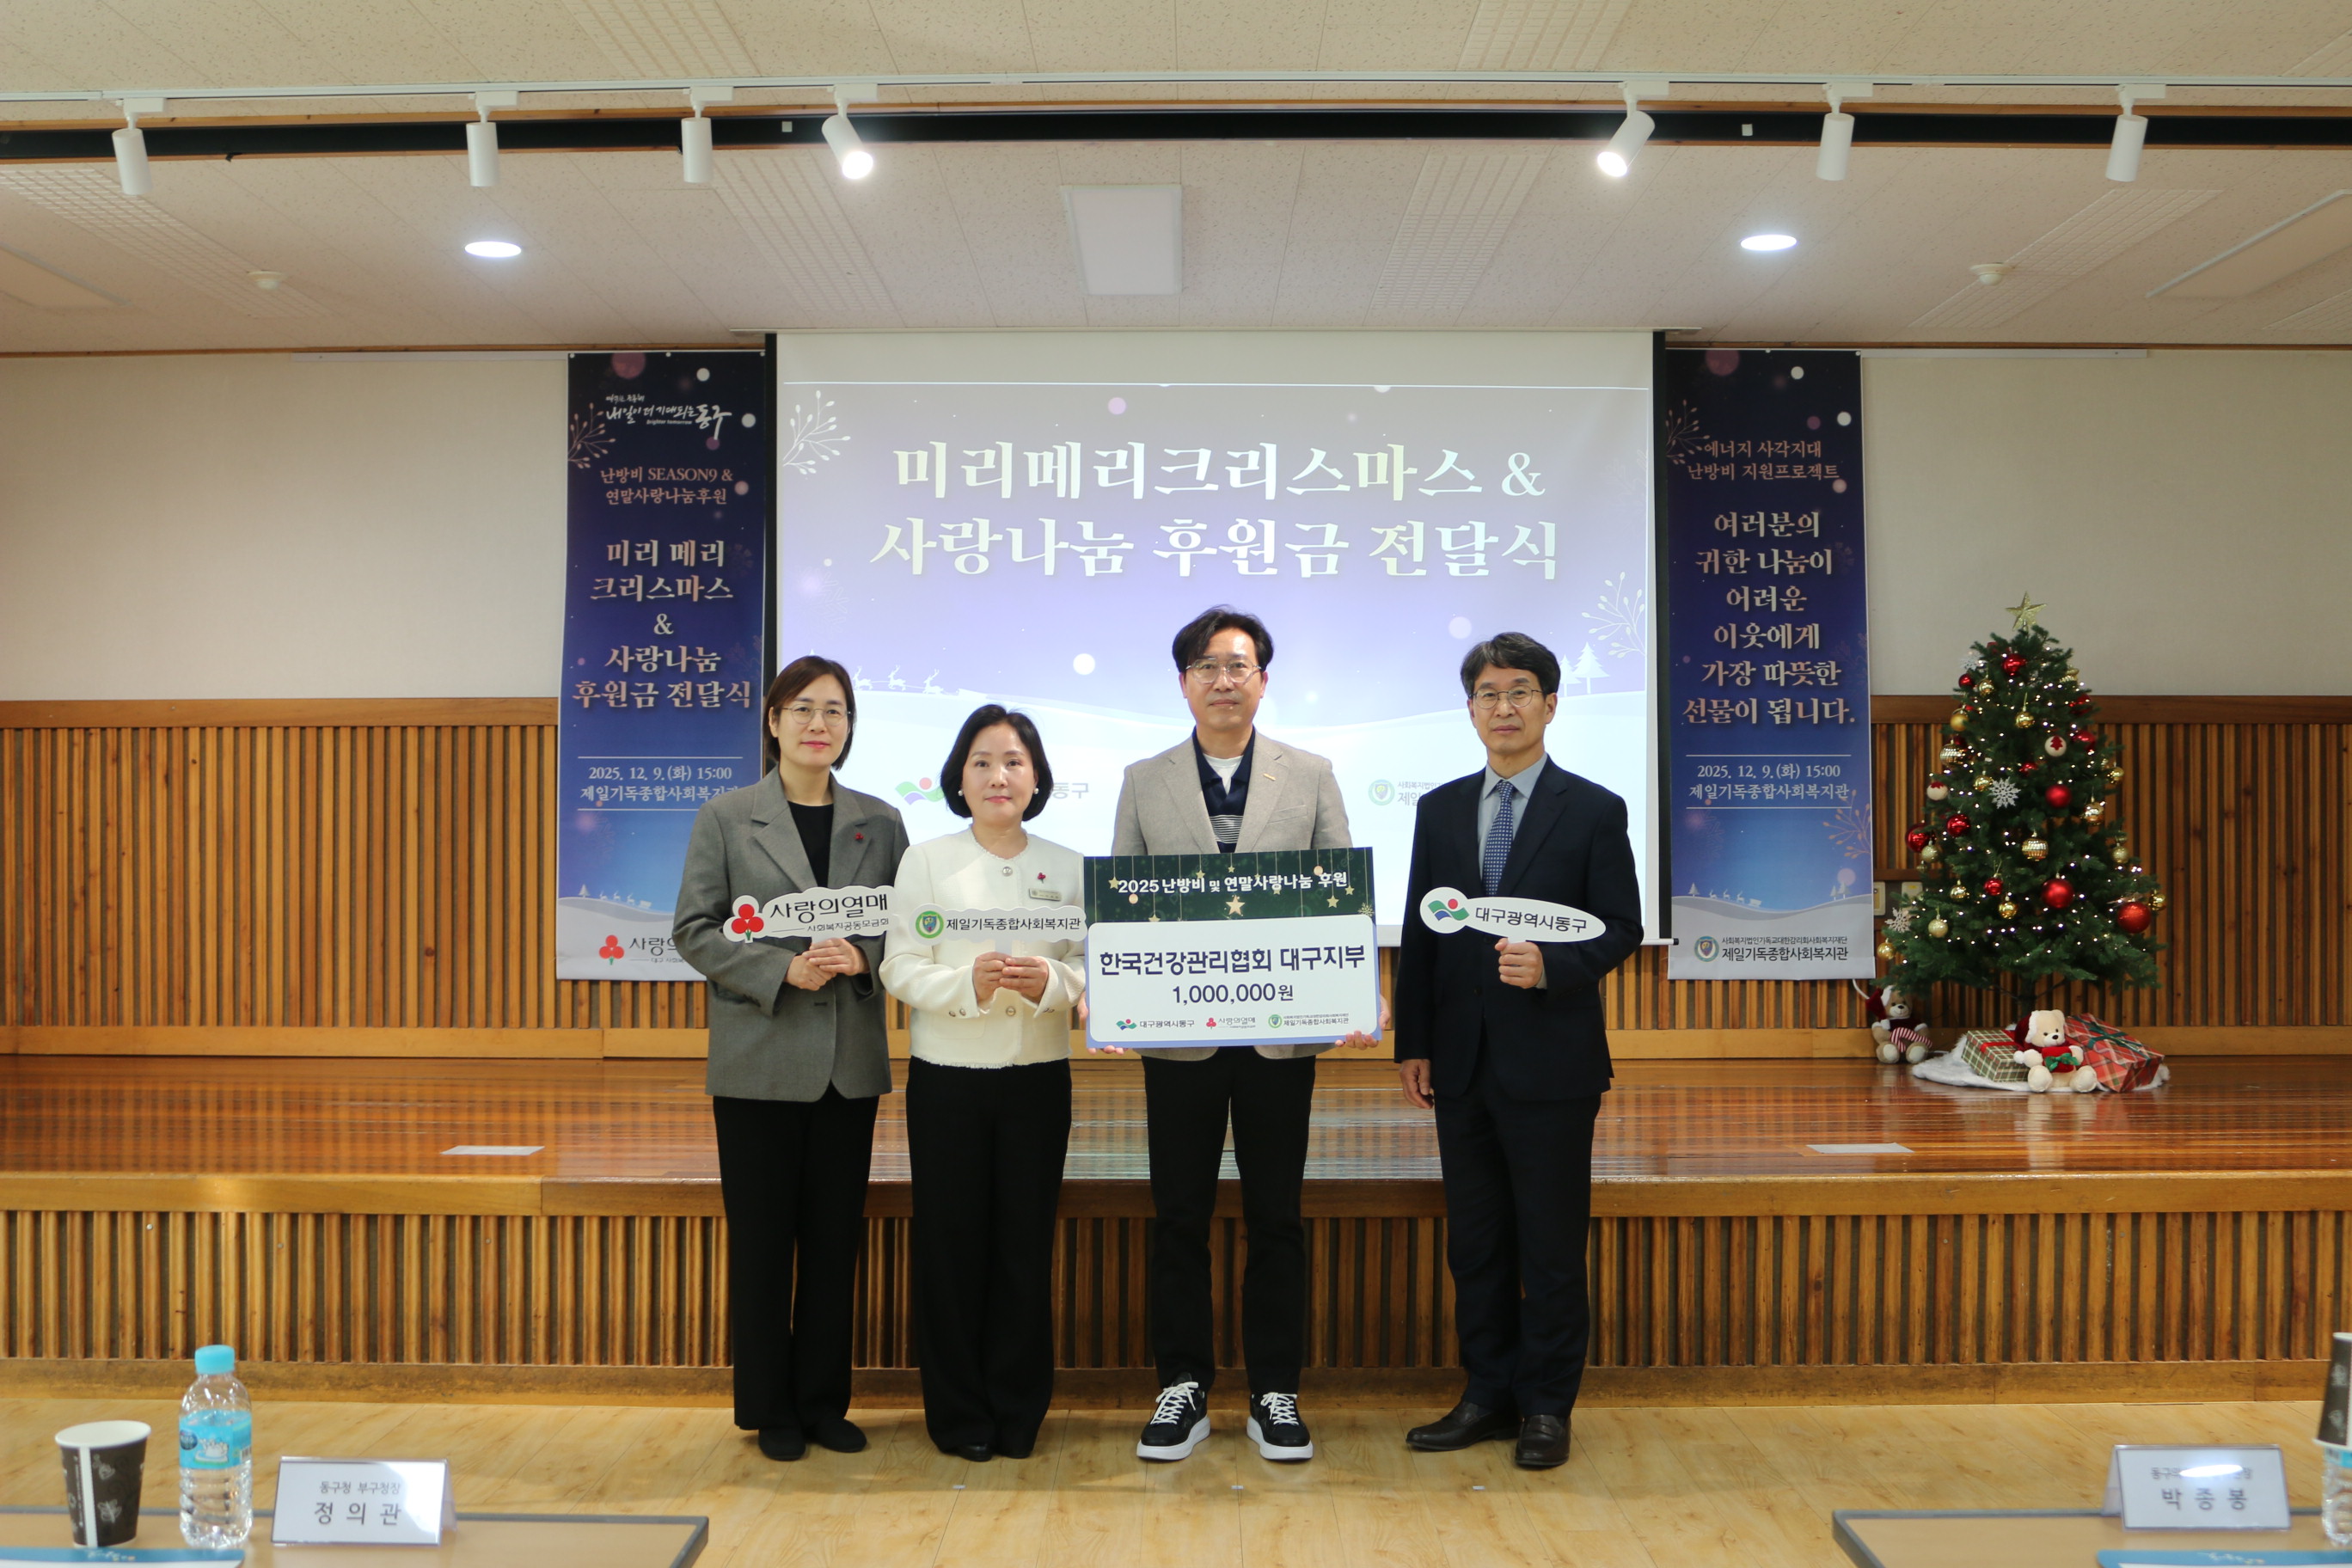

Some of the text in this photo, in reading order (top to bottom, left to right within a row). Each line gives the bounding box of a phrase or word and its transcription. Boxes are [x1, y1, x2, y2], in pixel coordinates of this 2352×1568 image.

[606, 404, 732, 440] 내일이 더 기대되는 동구
[1704, 440, 1822, 458] 에너지 사각지대
[600, 467, 733, 484] 난방비 SEASON9 &
[892, 441, 1547, 501] 미리메리크리스마스 &
[1687, 462, 1840, 481] 난방비 지원프로젝트
[606, 487, 727, 505] 연말사랑나눔후원
[1714, 511, 1820, 537] 여러분의
[607, 540, 725, 567] 미리 메리
[870, 517, 1556, 580] 사랑나눔 후원금 전달식
[1695, 548, 1832, 575] 귀한 나눔이
[590, 574, 733, 602] 크리스마스
[1726, 585, 1808, 612] 어려운
[653, 613, 674, 634] &
[1714, 622, 1820, 649] 이웃에게
[604, 645, 721, 673] 사랑나눔
[1701, 660, 1841, 687] 가장 따뜻한
[573, 681, 750, 708] 후원금 전달식
[1682, 697, 1855, 724] 선물이 됩니다.
[588, 767, 623, 781] 2025.
[629, 767, 648, 781] 12.
[697, 767, 732, 780] 15:00
[1697, 765, 1732, 779] 2025.
[1738, 765, 1756, 779] 12.
[1805, 765, 1841, 778] 15:00
[579, 785, 738, 801] 제일기독종합사회복지
[1688, 784, 1849, 799] 제일기독종합사회복지관
[1118, 871, 1348, 894] 2025 난방비 및 연말사랑나눔 후원
[770, 893, 888, 924] 사랑의열매
[1475, 907, 1588, 934] 대구광역시동구
[806, 917, 890, 932] 사회복지공동모금회
[946, 918, 1081, 931] 제일기독종합사회복지관
[1099, 945, 1365, 976] 한국건강관리협회 대구지부
[1722, 946, 1849, 961] 제일기독종합사회복지관
[1173, 983, 1294, 1006] 1,000,000원
[1140, 1020, 1195, 1028] 대구광역시동구
[319, 1481, 401, 1495] 동구청 부구청장
